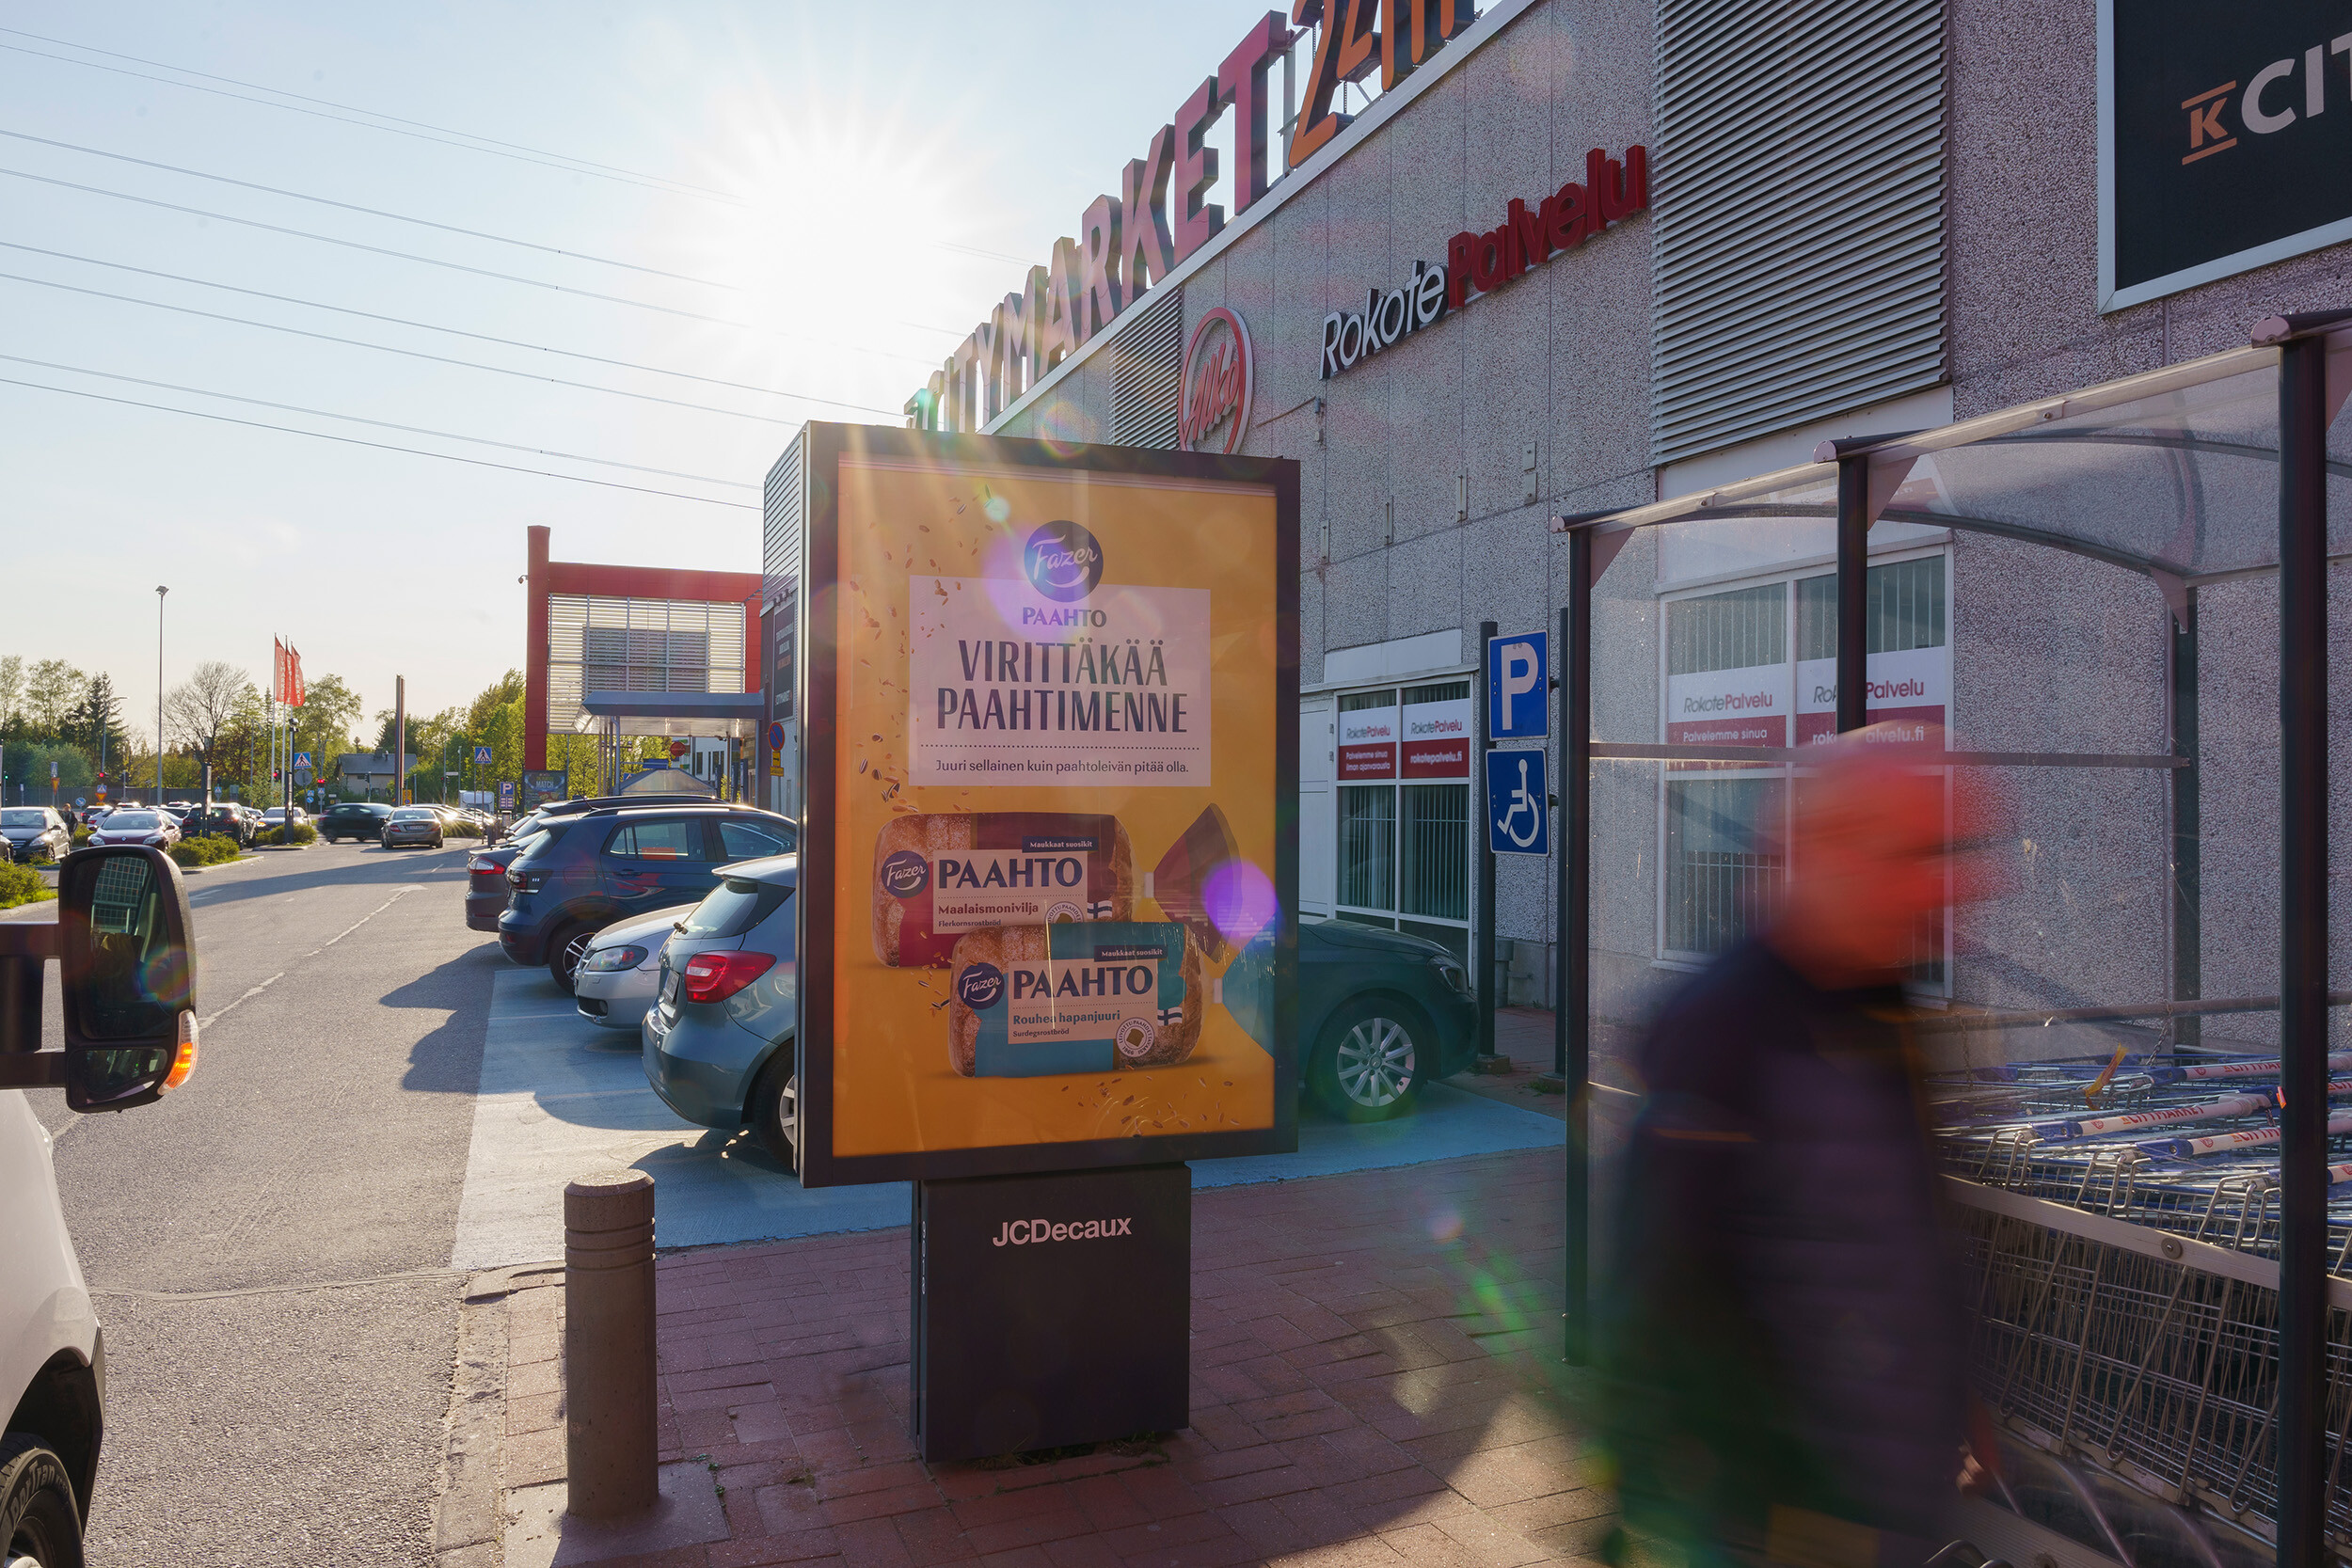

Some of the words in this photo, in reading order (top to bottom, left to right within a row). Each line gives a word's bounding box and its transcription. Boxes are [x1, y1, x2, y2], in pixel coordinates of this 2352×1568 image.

[2185, 87, 2233, 158] K
[923, 8, 1286, 432] CITYMARKET
[1320, 145, 1647, 381] RokotePalvelu
[1184, 342, 1240, 441] Alko
[1032, 533, 1098, 580] Fazer
[1023, 607, 1107, 628] PAAHTO
[958, 637, 1168, 687] VIRITTÄKÄÄ
[1501, 641, 1539, 730] P
[937, 688, 1187, 733] PAAHTIMENNE
[1683, 691, 1772, 714] RokotePalvelu
[1346, 724, 1391, 739] RokotePalvelu
[1411, 719, 1463, 735] RokotePalvelu
[1683, 730, 1740, 742] Palvelemme
[1740, 727, 1768, 739] sinua
[1345, 752, 1375, 760] Palvelemme
[1375, 750, 1389, 759] sinua
[1410, 751, 1463, 765] rokotepalvelu.fi
[936, 759, 966, 771] Juuri
[969, 759, 1024, 772] sellainen
[1027, 760, 1053, 772] kuin
[1056, 760, 1132, 775] paahtoleivän
[1134, 761, 1164, 775] pitää
[1166, 761, 1189, 773] olla.
[502, 783, 513, 794] P
[885, 858, 926, 887] Fazer
[938, 857, 1083, 889] PAAHTO
[938, 904, 1039, 915] Maalaismonivilja
[938, 919, 1002, 927] Flerkornsrostbröd
[962, 970, 1002, 999] Fazer
[1013, 965, 1153, 1000] PAAHTO
[1013, 1013, 1057, 1024] Rouhea
[1058, 1010, 1120, 1024] hapanjuuri
[1012, 1028, 1070, 1037] Surdegsrostbröd
[2231, 1063, 2280, 1072] CITYMA
[993, 1217, 1132, 1247] JCDecaux
